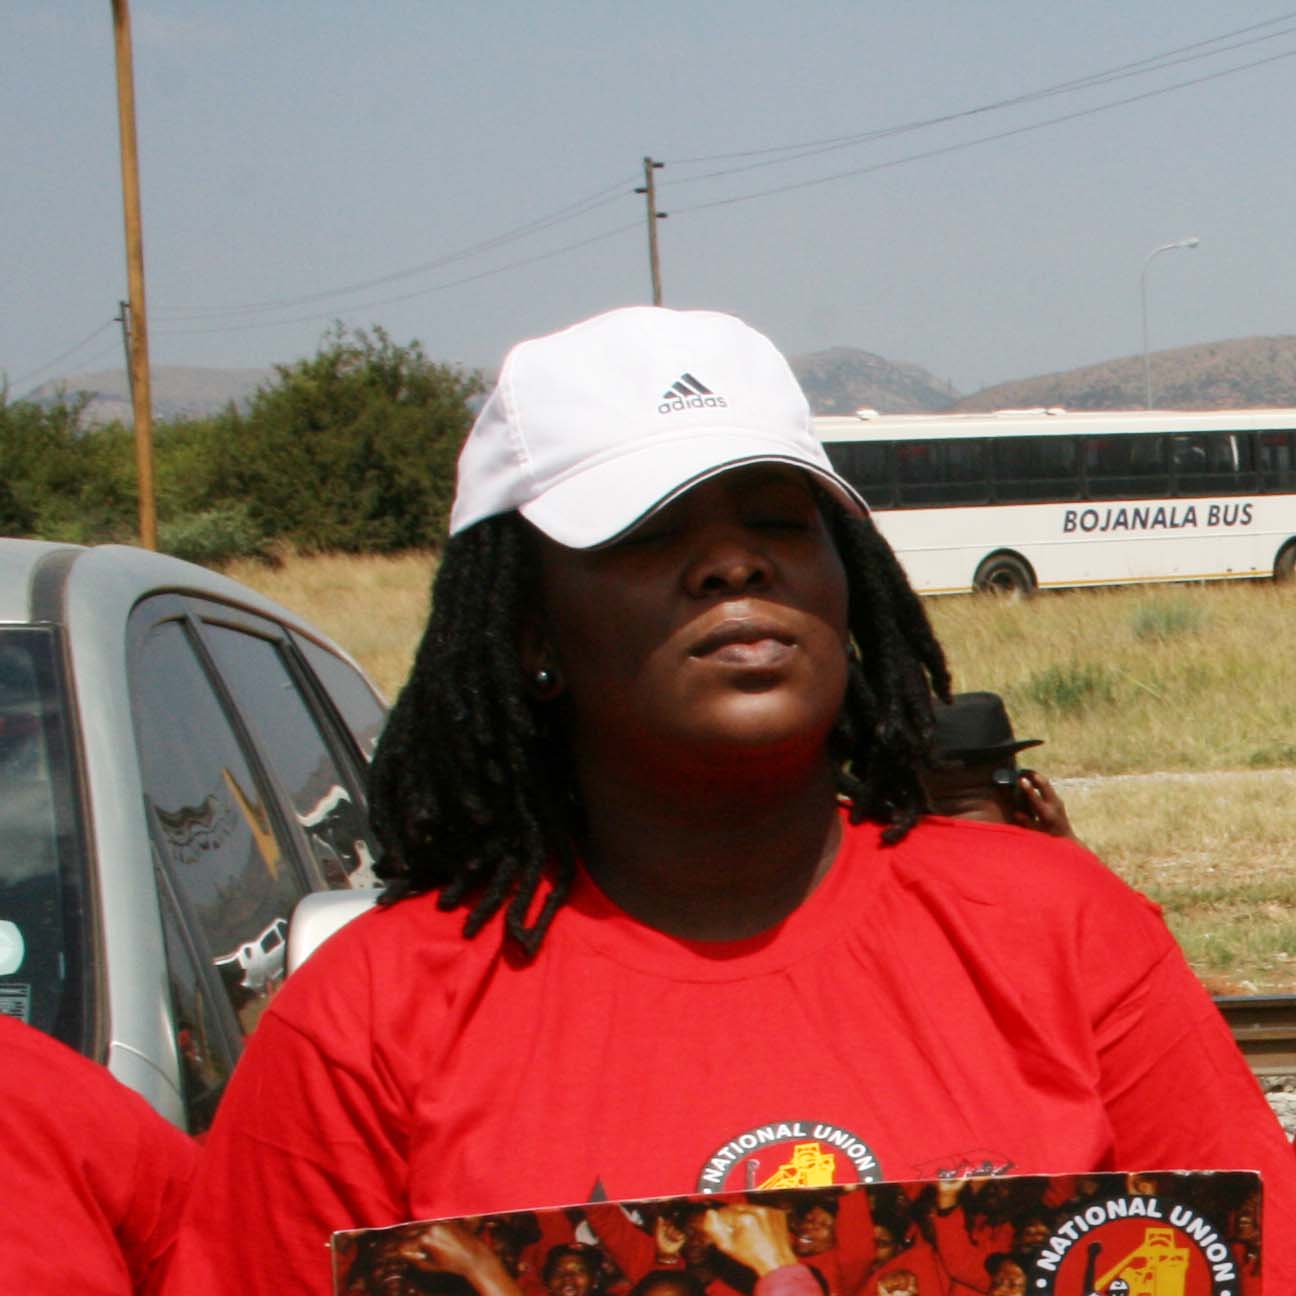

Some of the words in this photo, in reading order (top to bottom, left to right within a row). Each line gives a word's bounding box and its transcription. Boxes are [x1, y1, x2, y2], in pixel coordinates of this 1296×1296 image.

[657, 395, 728, 415] adidas
[1063, 505, 1197, 533] BOJANALA
[1207, 503, 1253, 527] BUS
[704, 1123, 806, 1183] NATIONAL
[813, 1124, 876, 1172] UNION
[1037, 1197, 1162, 1271] NATIONAL
[1169, 1206, 1235, 1282] UNION
